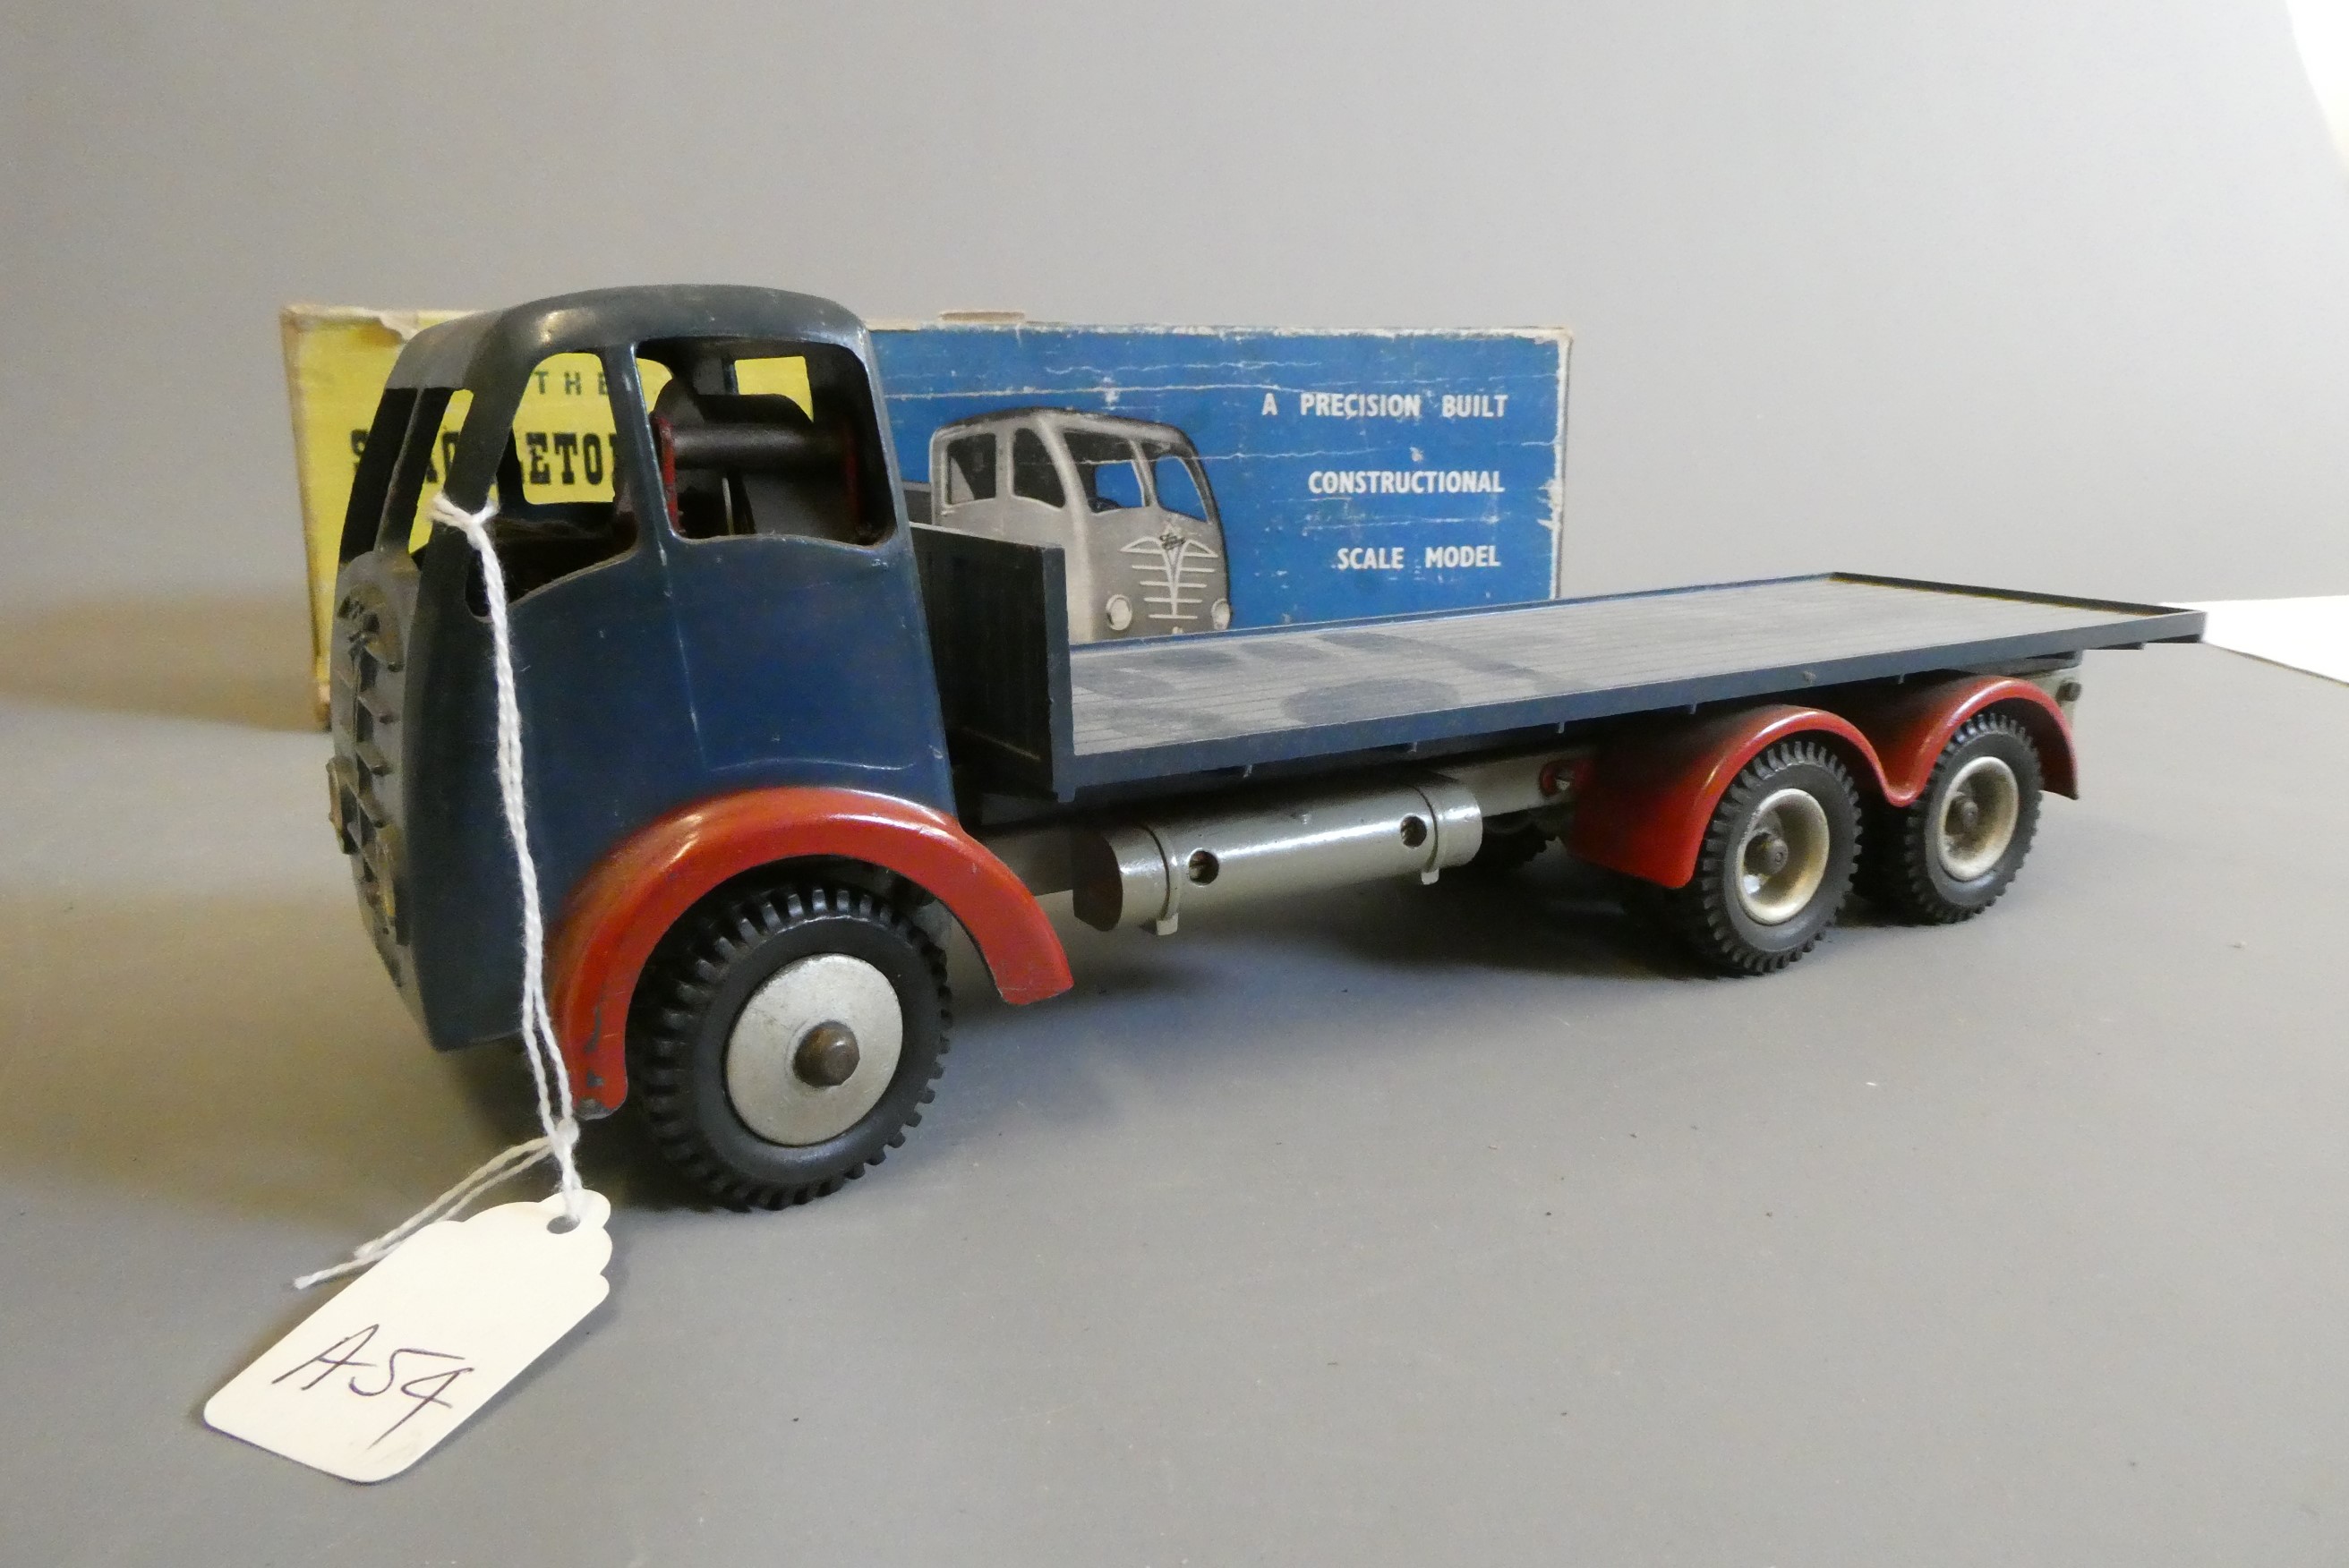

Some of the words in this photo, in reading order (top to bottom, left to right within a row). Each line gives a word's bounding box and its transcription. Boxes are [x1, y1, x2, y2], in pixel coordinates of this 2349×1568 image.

[534, 370, 609, 396] THE
[1261, 393, 1278, 416] A
[1300, 393, 1422, 417] PRECISION
[1441, 394, 1508, 418] BUILT
[1308, 470, 1506, 494] CONSTRUCTIONAL
[1337, 547, 1405, 570] SCALE
[1424, 545, 1501, 568] MODEL
[271, 1323, 475, 1451] A54
